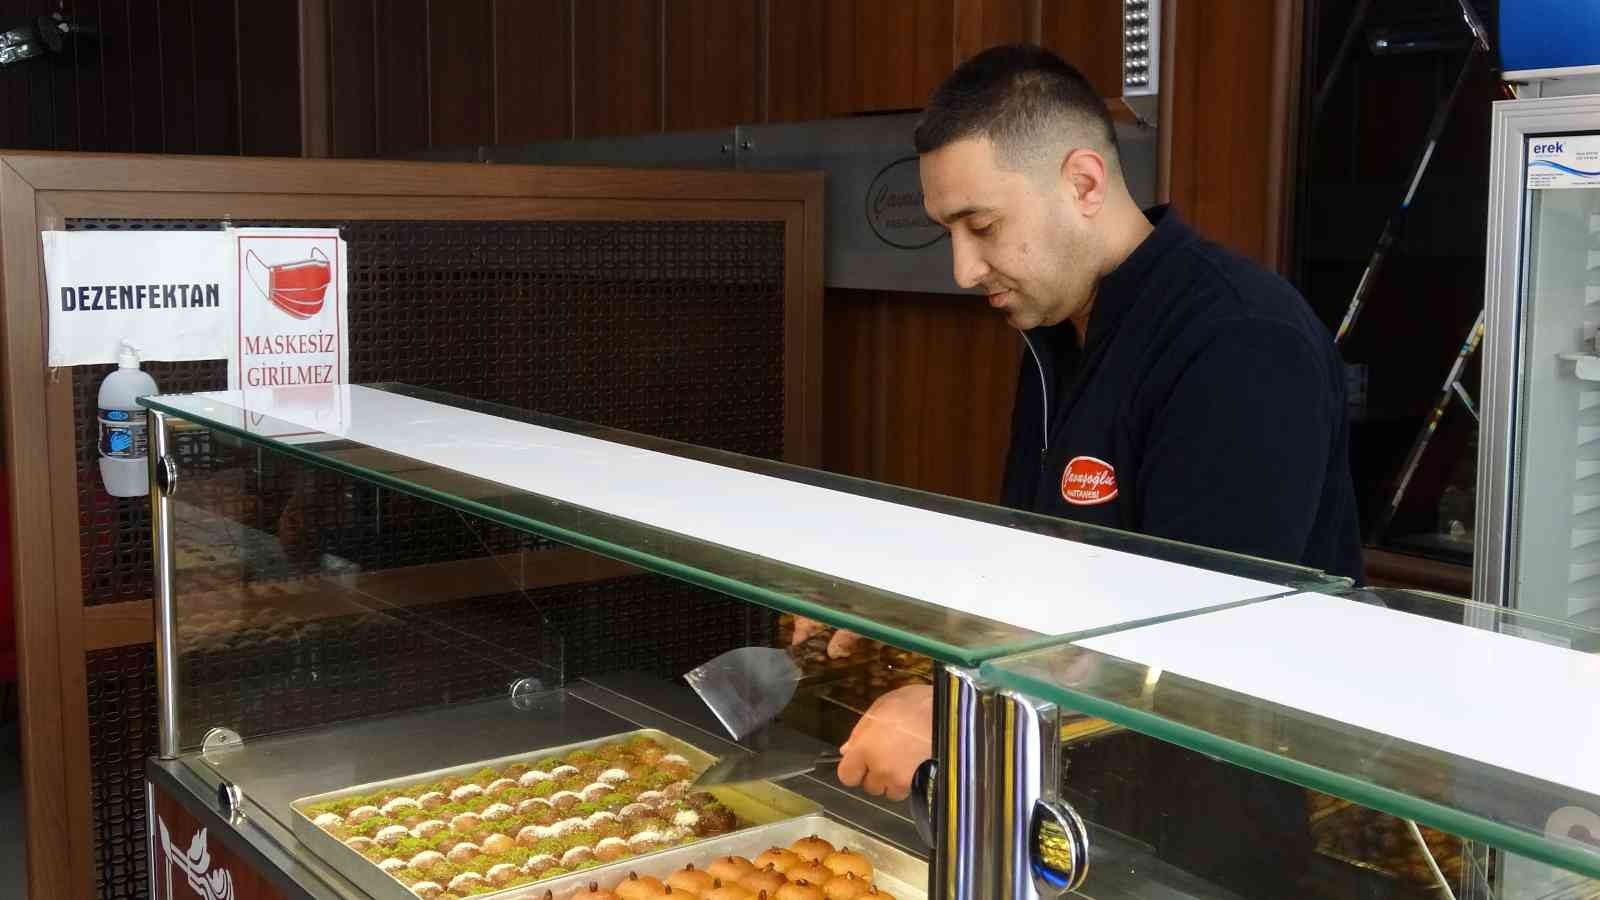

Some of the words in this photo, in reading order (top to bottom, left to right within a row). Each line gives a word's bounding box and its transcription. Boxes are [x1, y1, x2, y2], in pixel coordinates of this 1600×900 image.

[1534, 141, 1563, 154] erek
[61, 283, 220, 312] DEZENFEKTAN
[244, 329, 335, 355] MASKESİZ
[247, 361, 333, 387] GİRİLMEZ
